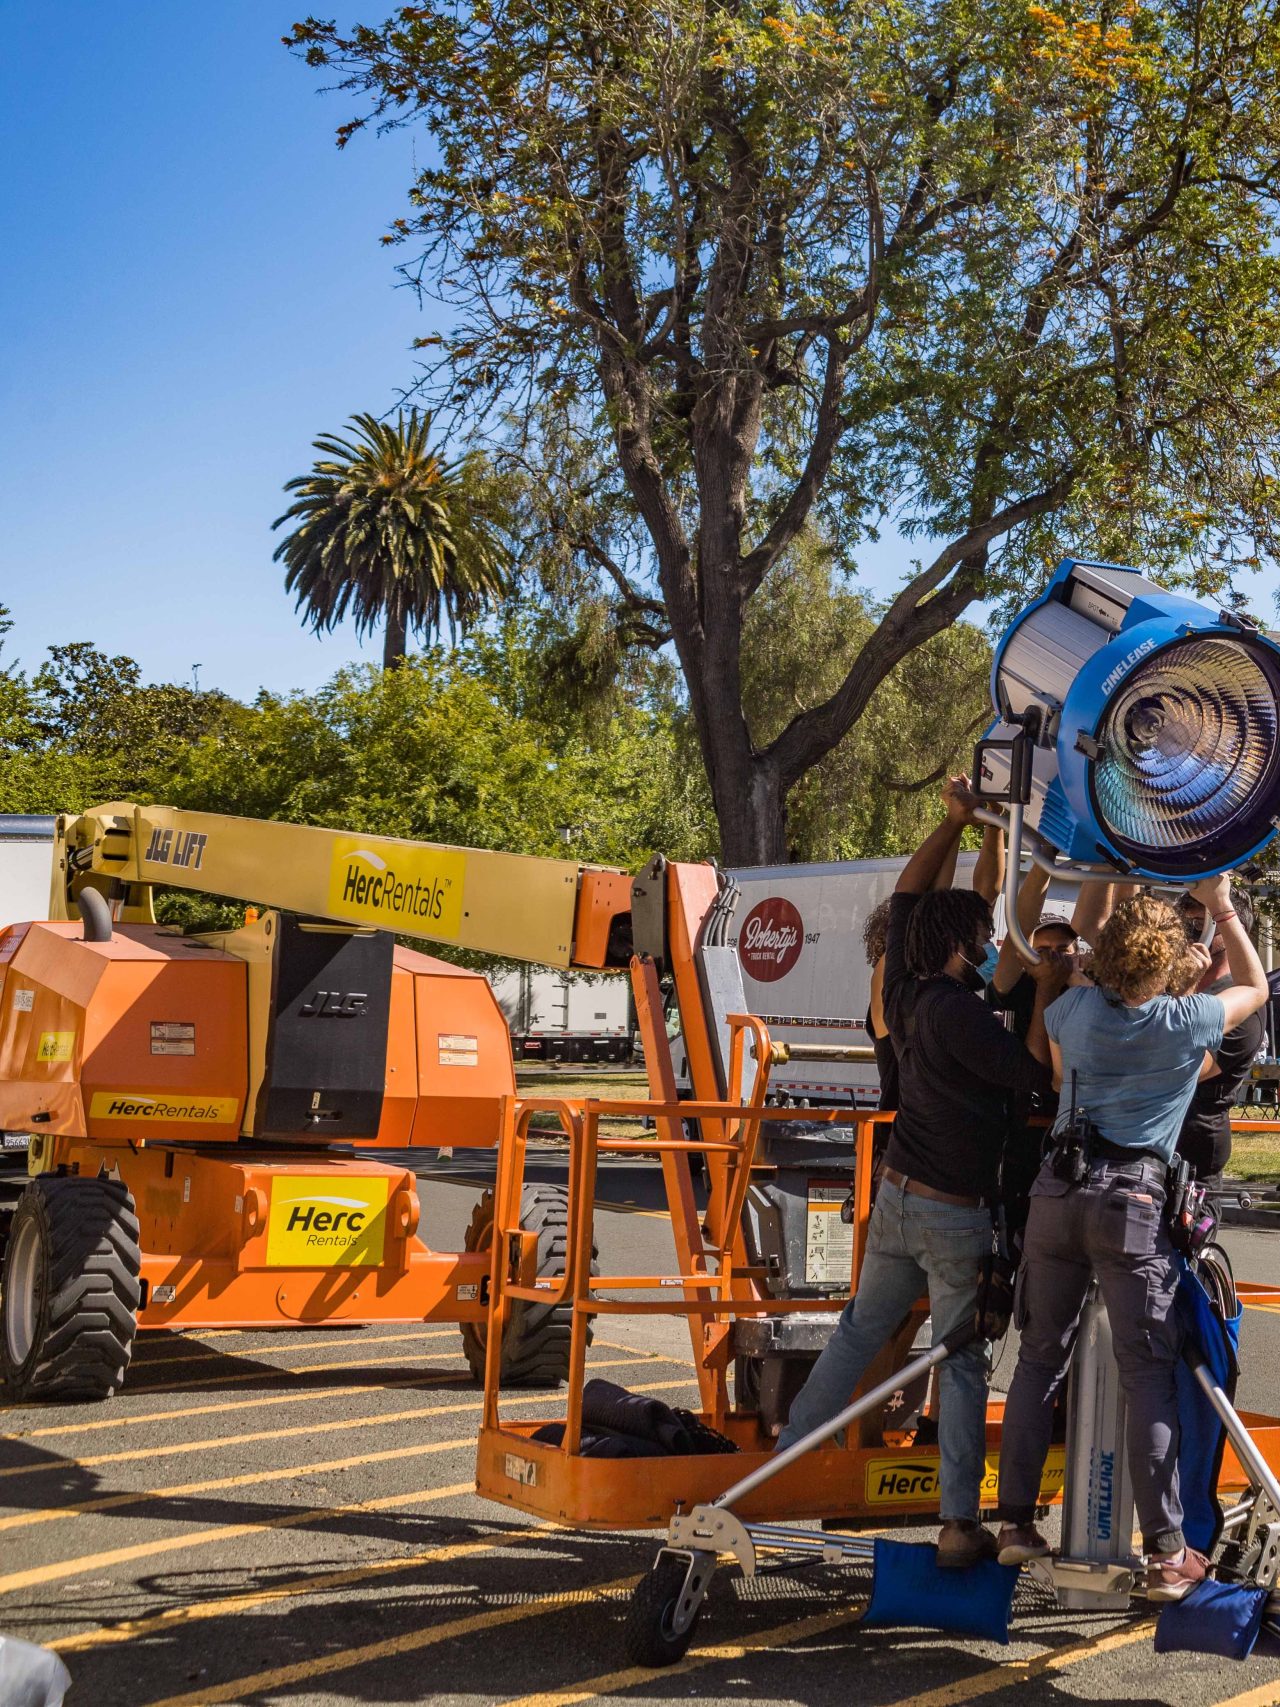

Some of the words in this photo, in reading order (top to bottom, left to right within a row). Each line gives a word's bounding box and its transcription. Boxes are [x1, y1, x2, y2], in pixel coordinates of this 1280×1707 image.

[1101, 638, 1158, 696] CINELEASE
[145, 826, 169, 865] JLG
[171, 829, 209, 871] LIFT
[343, 864, 444, 919] HercRentals
[744, 916, 798, 964] Doherty's
[804, 933, 820, 944] 1947
[750, 952, 761, 960] TRUCK
[299, 991, 368, 1018] JLG
[108, 1101, 219, 1119] HercRentals
[286, 1206, 366, 1232] Herc
[306, 1234, 358, 1247] Rentals
[1087, 1446, 1114, 1540] CINELEASE
